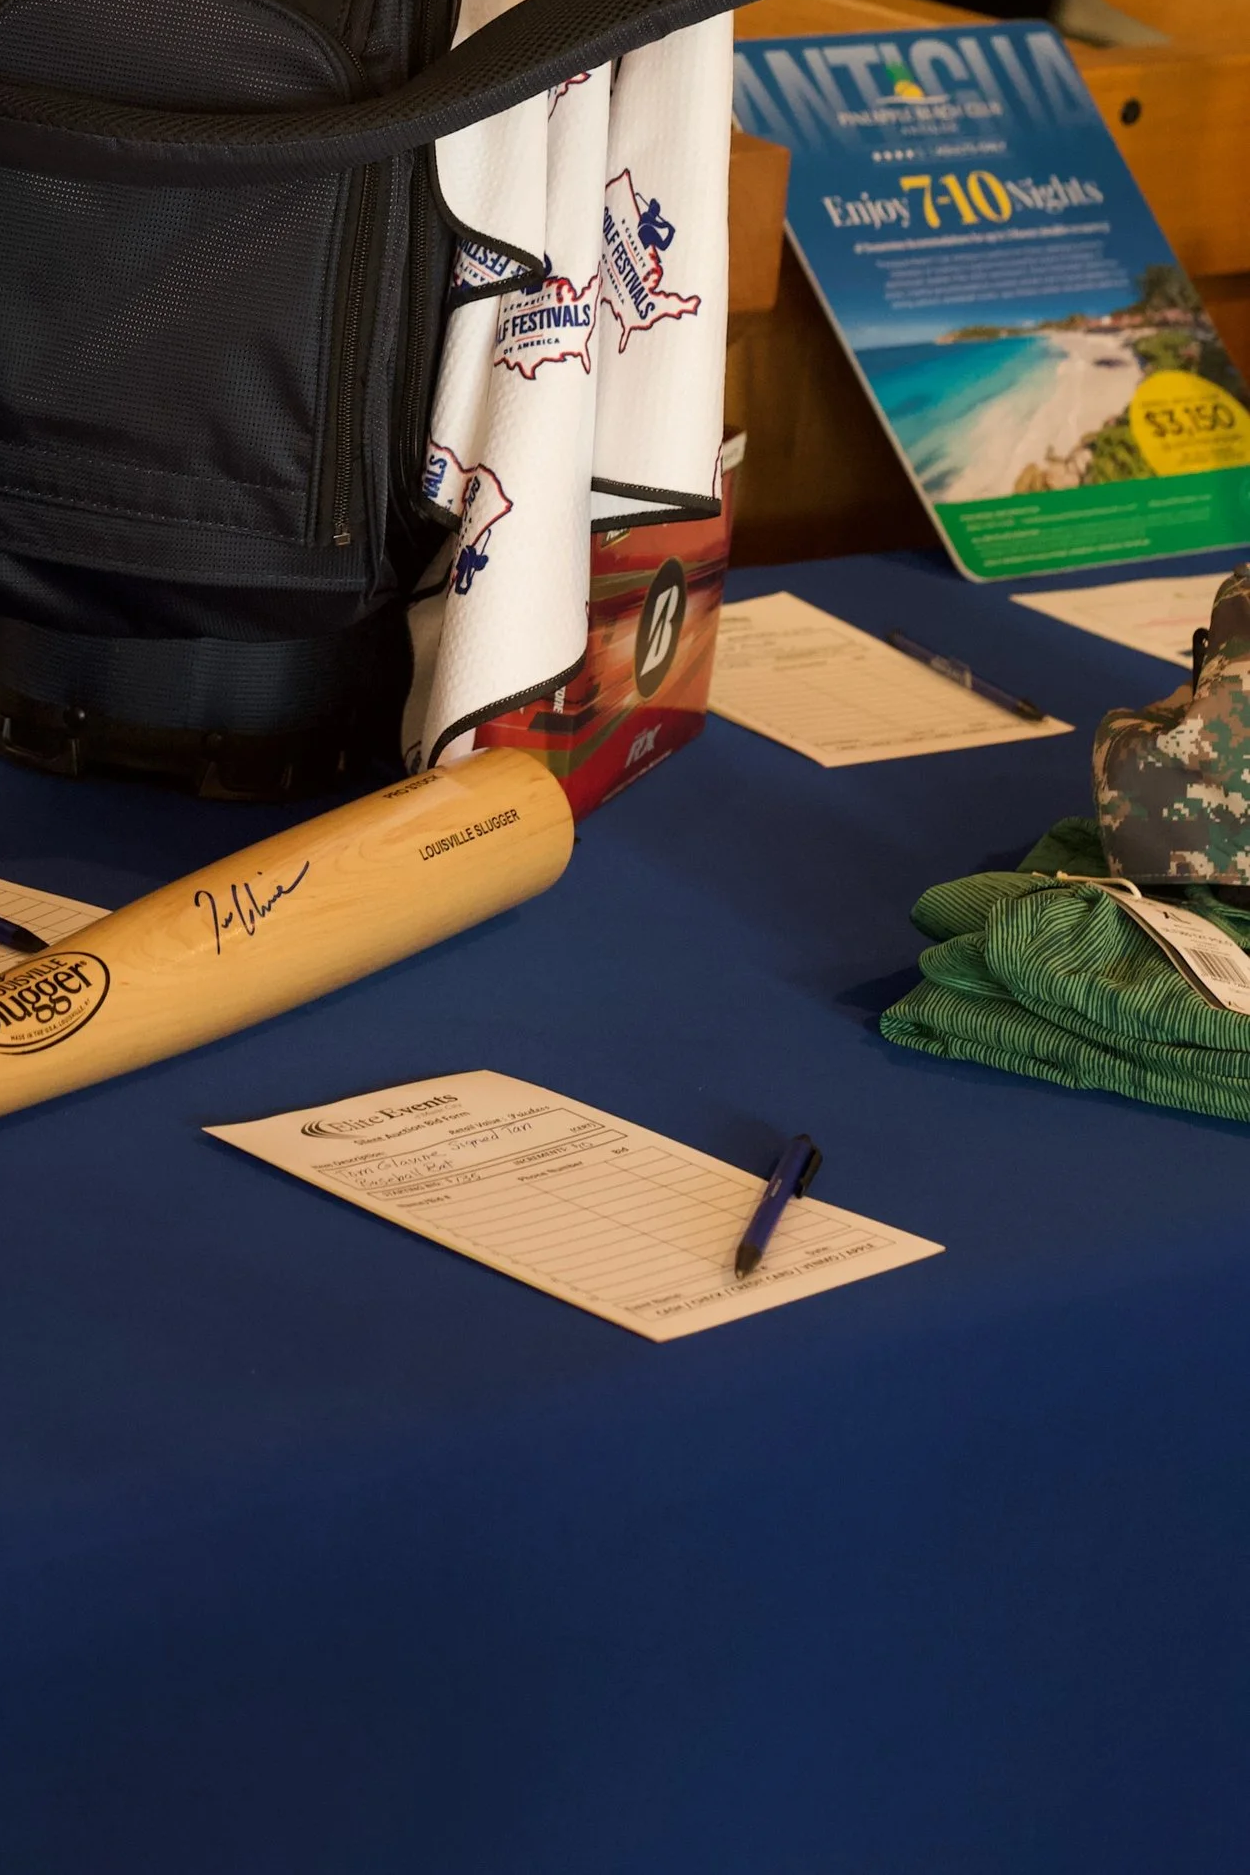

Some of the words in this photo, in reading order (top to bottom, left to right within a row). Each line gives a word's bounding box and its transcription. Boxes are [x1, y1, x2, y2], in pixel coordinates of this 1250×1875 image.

[822, 191, 910, 229] Enjoy
[900, 170, 1012, 228] 7-10
[1005, 173, 1104, 215] Nights
[612, 240, 656, 320] FESTIVALS
[511, 303, 591, 337] FESTIVALS
[517, 337, 560, 351] AMERICA
[419, 827, 475, 861] LOUISVILLE
[473, 808, 520, 837] SLUGGER
[325, 1115, 384, 1133] Elite
[376, 1094, 459, 1119] Events
[353, 1136, 385, 1146] Silent
[385, 1122, 424, 1139] Auction
[424, 1116, 444, 1126] Bid
[442, 1110, 471, 1121] Form
[449, 1124, 474, 1135] Retail
[448, 1128, 500, 1149] Signed
[611, 1145, 630, 1156] Bid
